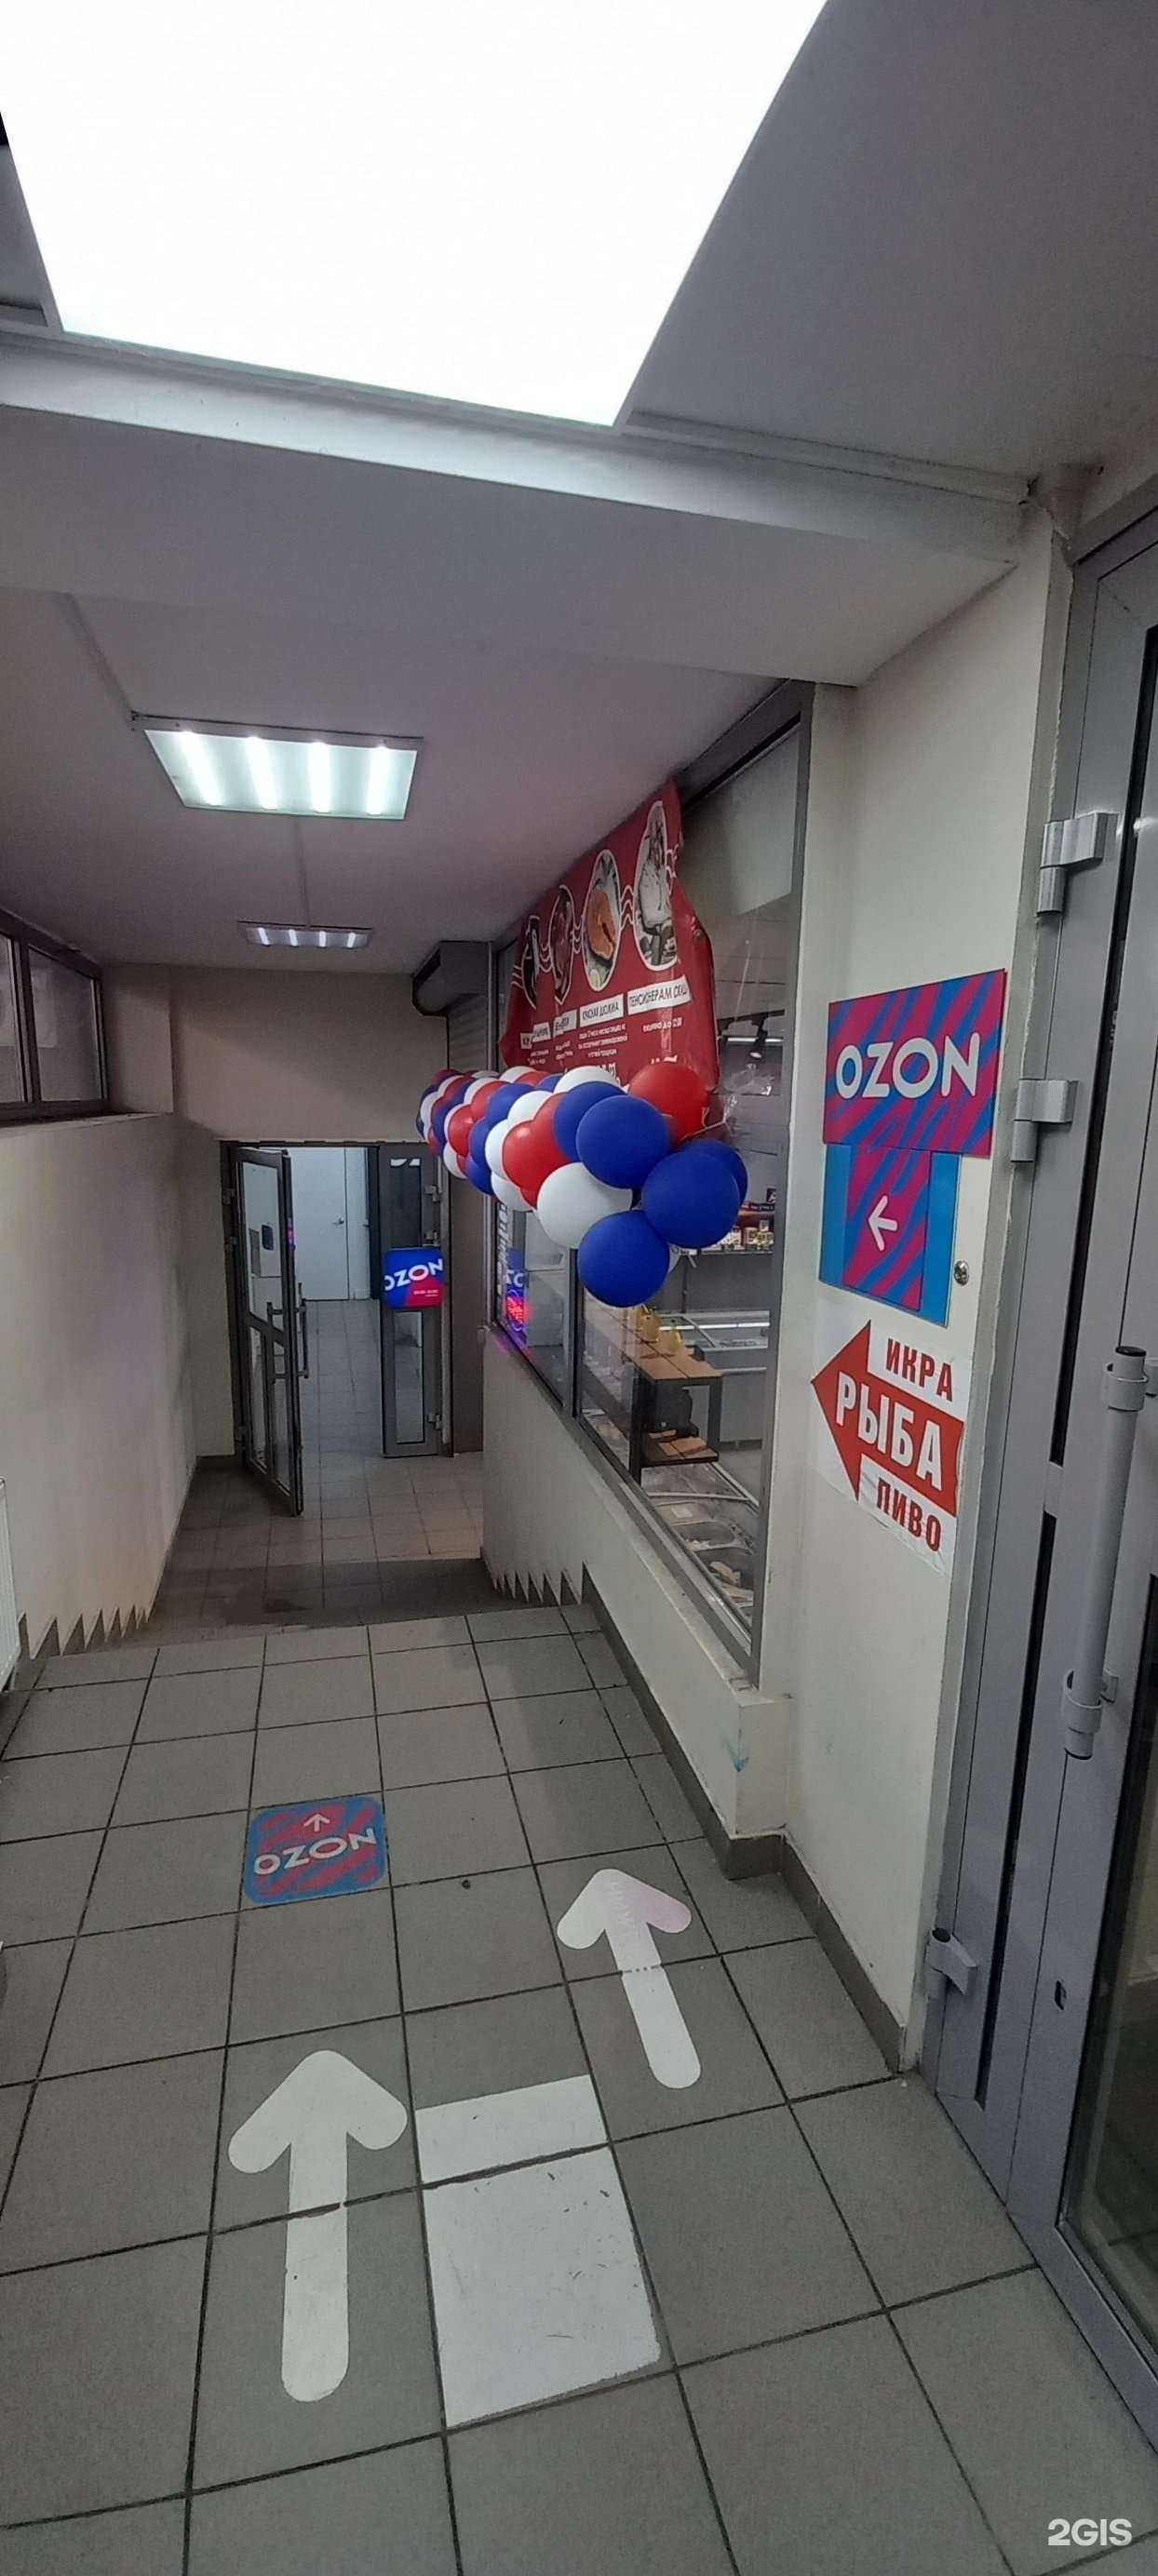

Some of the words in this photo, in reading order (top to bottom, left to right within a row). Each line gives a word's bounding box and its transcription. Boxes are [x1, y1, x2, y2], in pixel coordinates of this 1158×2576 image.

[836, 1033, 980, 1099] OZON
[885, 1337, 953, 1402] ИКРА
[836, 1370, 943, 1491] РЫБА
[876, 1477, 943, 1552] ПИВО
[253, 1827, 377, 1875] OZON
